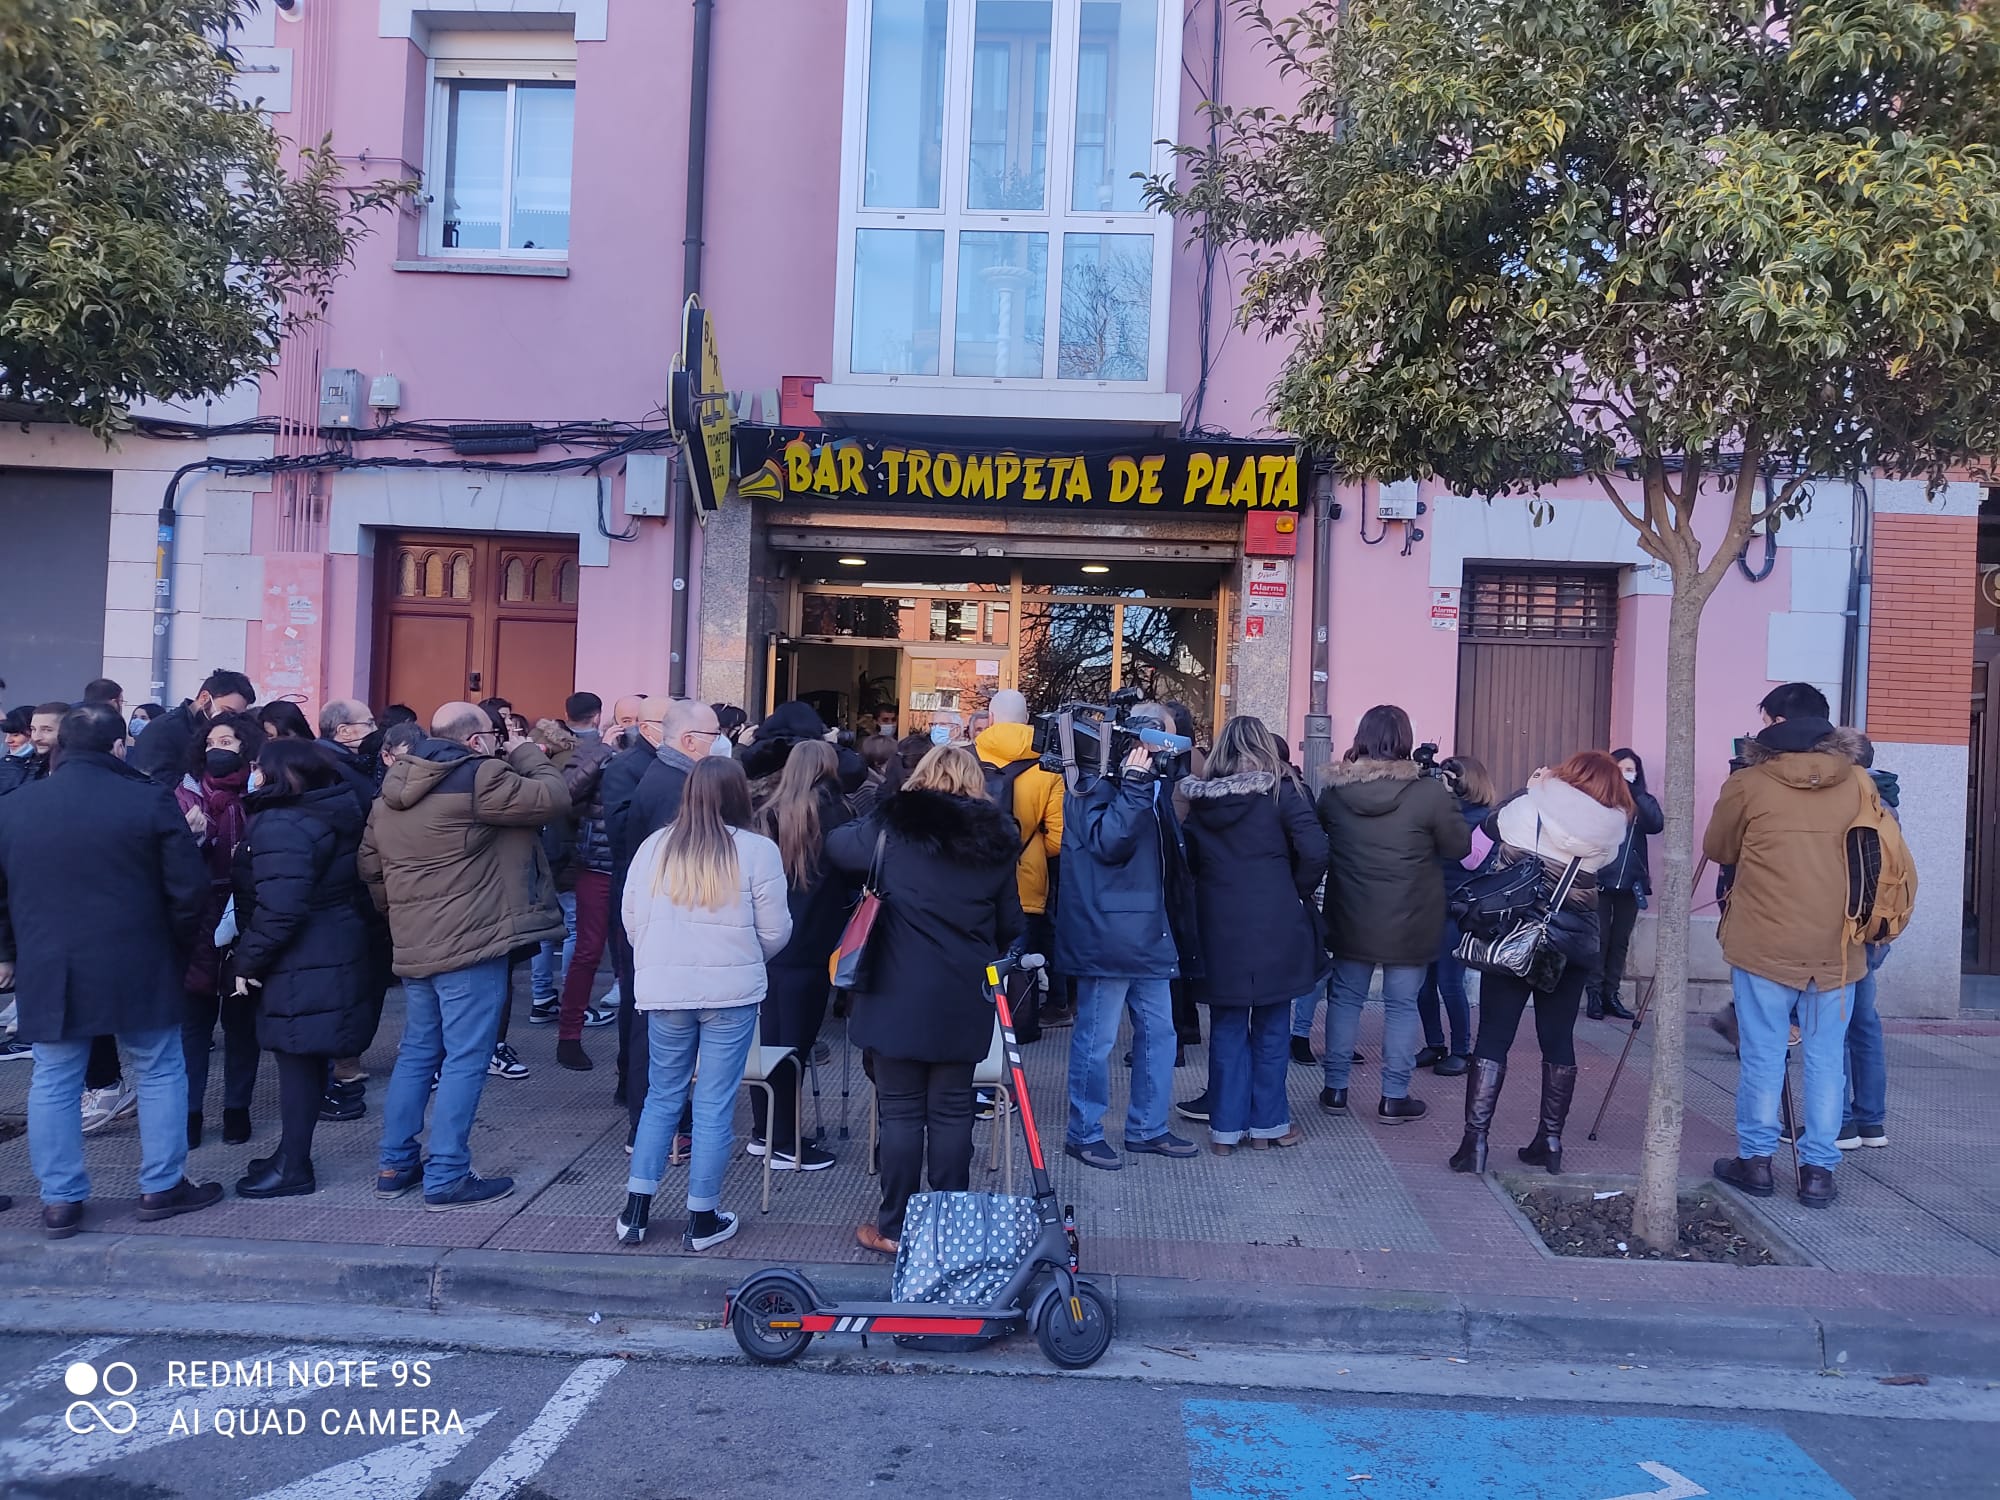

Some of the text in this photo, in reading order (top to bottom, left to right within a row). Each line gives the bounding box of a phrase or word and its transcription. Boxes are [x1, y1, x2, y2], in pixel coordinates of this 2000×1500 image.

[703, 319, 719, 377] BAR
[707, 431, 730, 449] TROMPETA
[711, 464, 725, 480] PLATA
[783, 441, 1299, 508] BAR TROMPETA DE PLATA
[466, 486, 482, 508] 7
[1251, 583, 1285, 593] Alarma
